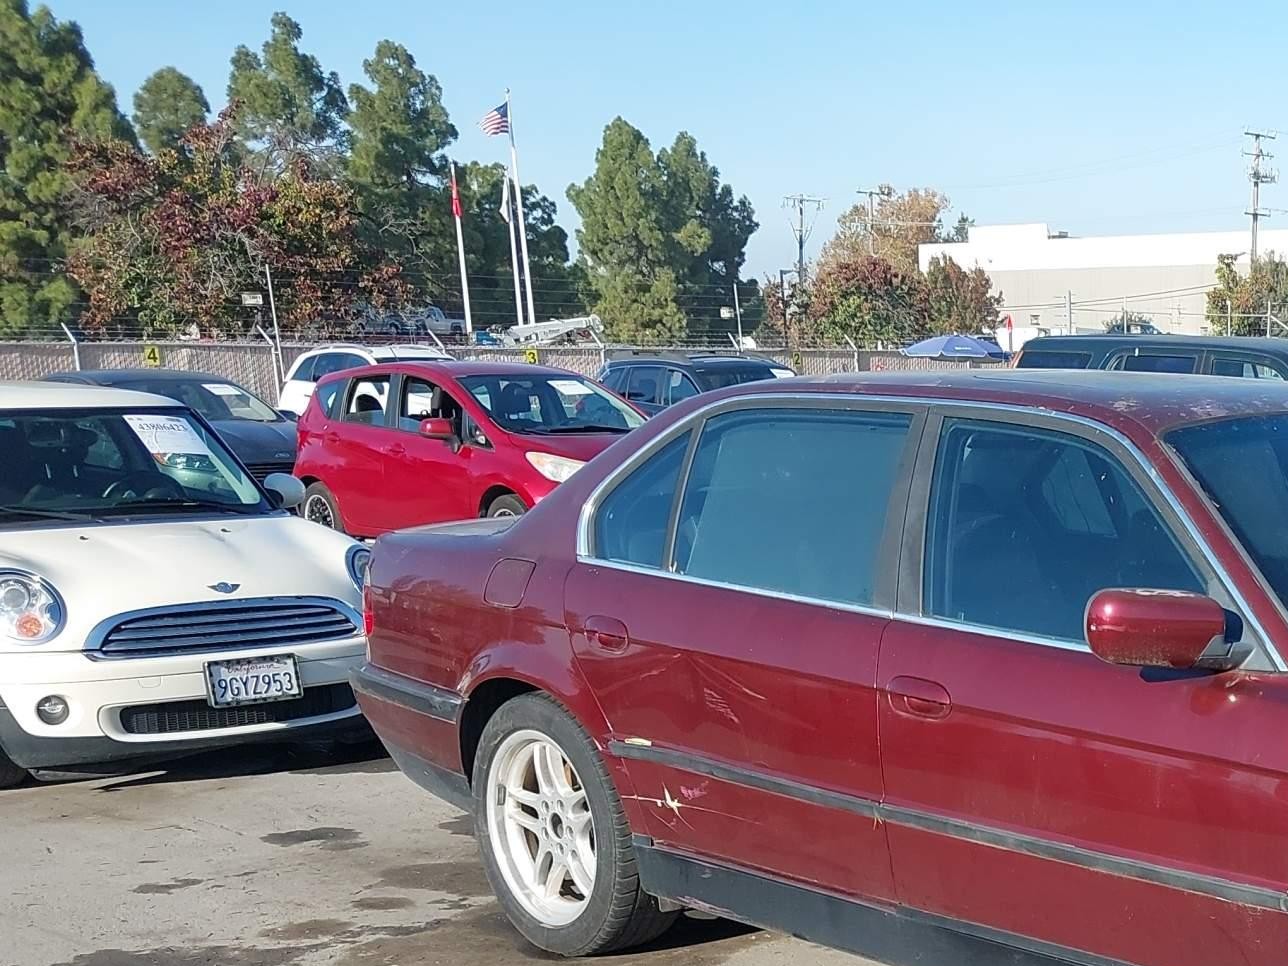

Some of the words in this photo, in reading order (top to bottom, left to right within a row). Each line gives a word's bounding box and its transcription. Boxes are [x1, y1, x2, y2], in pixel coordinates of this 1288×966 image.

[147, 347, 158, 363] 4
[527, 351, 537, 365] 3
[793, 353, 801, 365] 2
[217, 671, 294, 699] 9GYZ953
